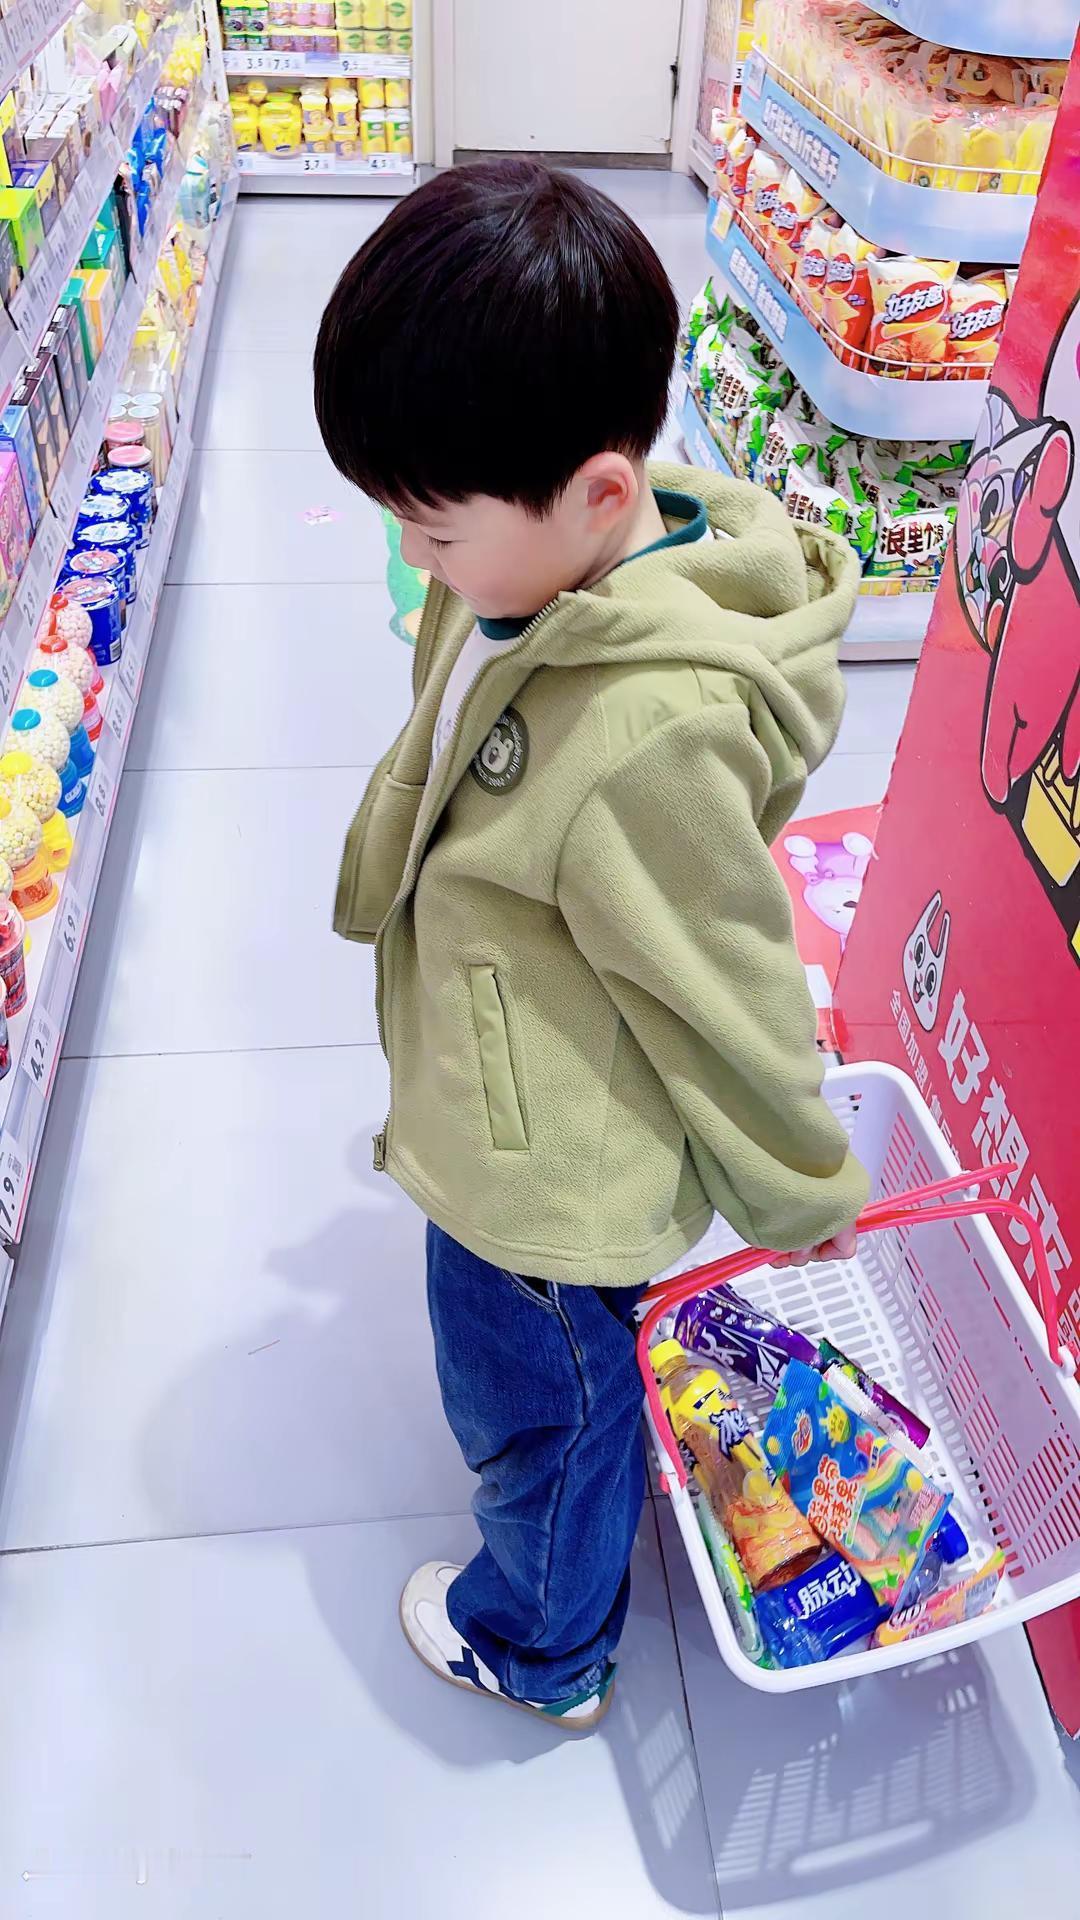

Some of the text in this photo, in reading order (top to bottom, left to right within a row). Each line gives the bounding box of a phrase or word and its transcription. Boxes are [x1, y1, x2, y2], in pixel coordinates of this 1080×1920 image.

[882, 284, 944, 324] 好友趣
[950, 303, 1004, 340] 好友趣
[64, 914, 76, 953] 6.9
[31, 1039, 46, 1081] 4.2
[797, 1561, 862, 1620] 脉动
